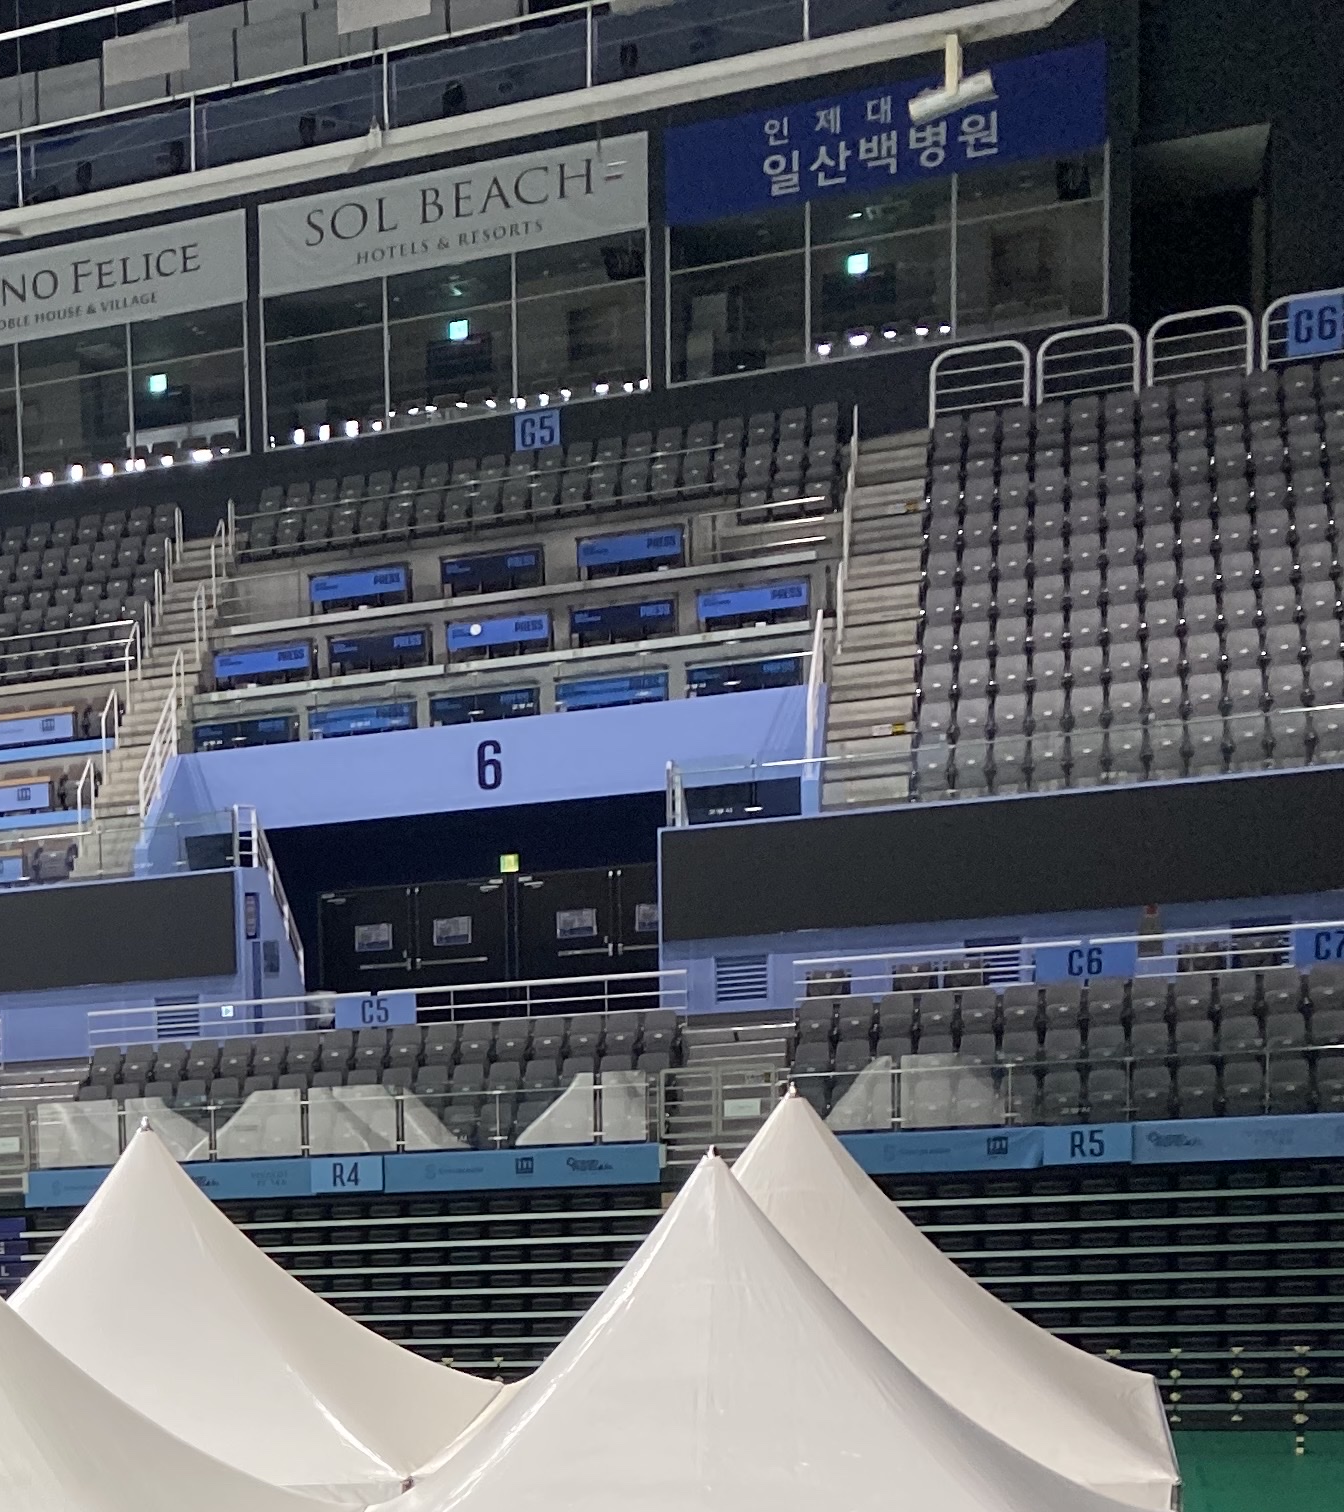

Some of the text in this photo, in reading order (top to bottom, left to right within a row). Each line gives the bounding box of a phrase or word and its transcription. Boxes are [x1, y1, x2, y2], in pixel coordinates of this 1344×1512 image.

[763, 110, 999, 196] 일산백병원
[305, 158, 595, 247] SOL BEACH
[356, 220, 544, 265] HOTELS & RESORTS
[72, 243, 201, 295] FELICE
[34, 305, 83, 325] HOUSE
[86, 306, 97, 316] &
[99, 292, 158, 313] VILLAGE
[1293, 304, 1338, 345] G6
[521, 414, 554, 449] G5
[477, 739, 503, 791] 6
[1068, 948, 1104, 977] C6
[361, 998, 389, 1024] C5
[1070, 1129, 1105, 1158] R5
[332, 1161, 359, 1188] R4
